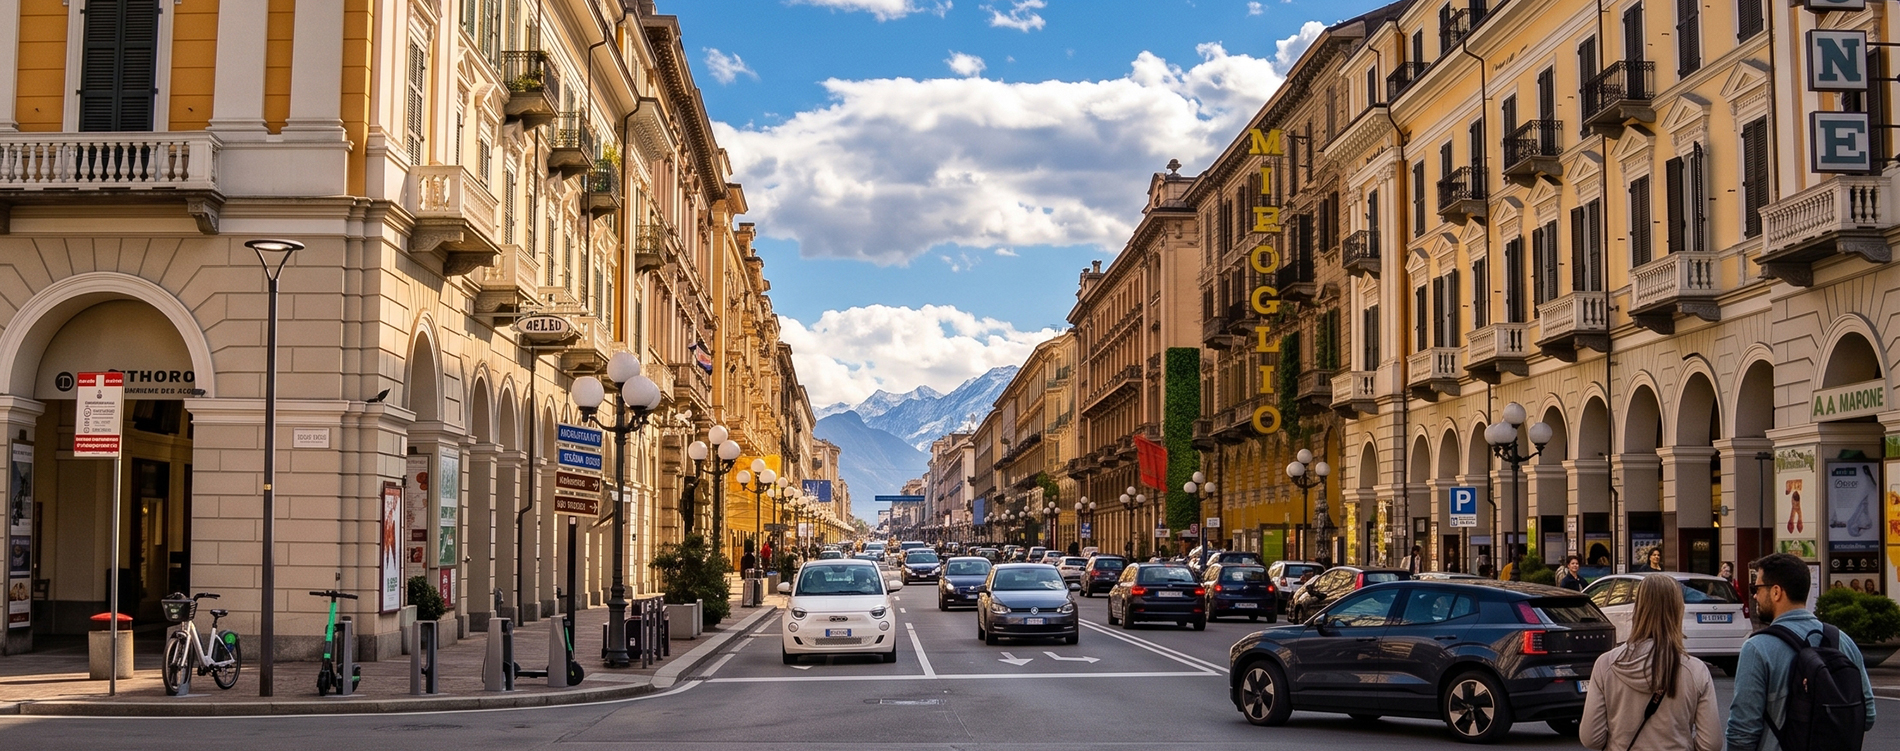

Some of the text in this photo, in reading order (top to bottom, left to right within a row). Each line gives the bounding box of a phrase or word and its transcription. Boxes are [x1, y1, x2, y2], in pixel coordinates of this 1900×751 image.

[1816, 0, 1867, 164] NE
[108, 369, 195, 383] THORO
[1456, 490, 1471, 511] P
